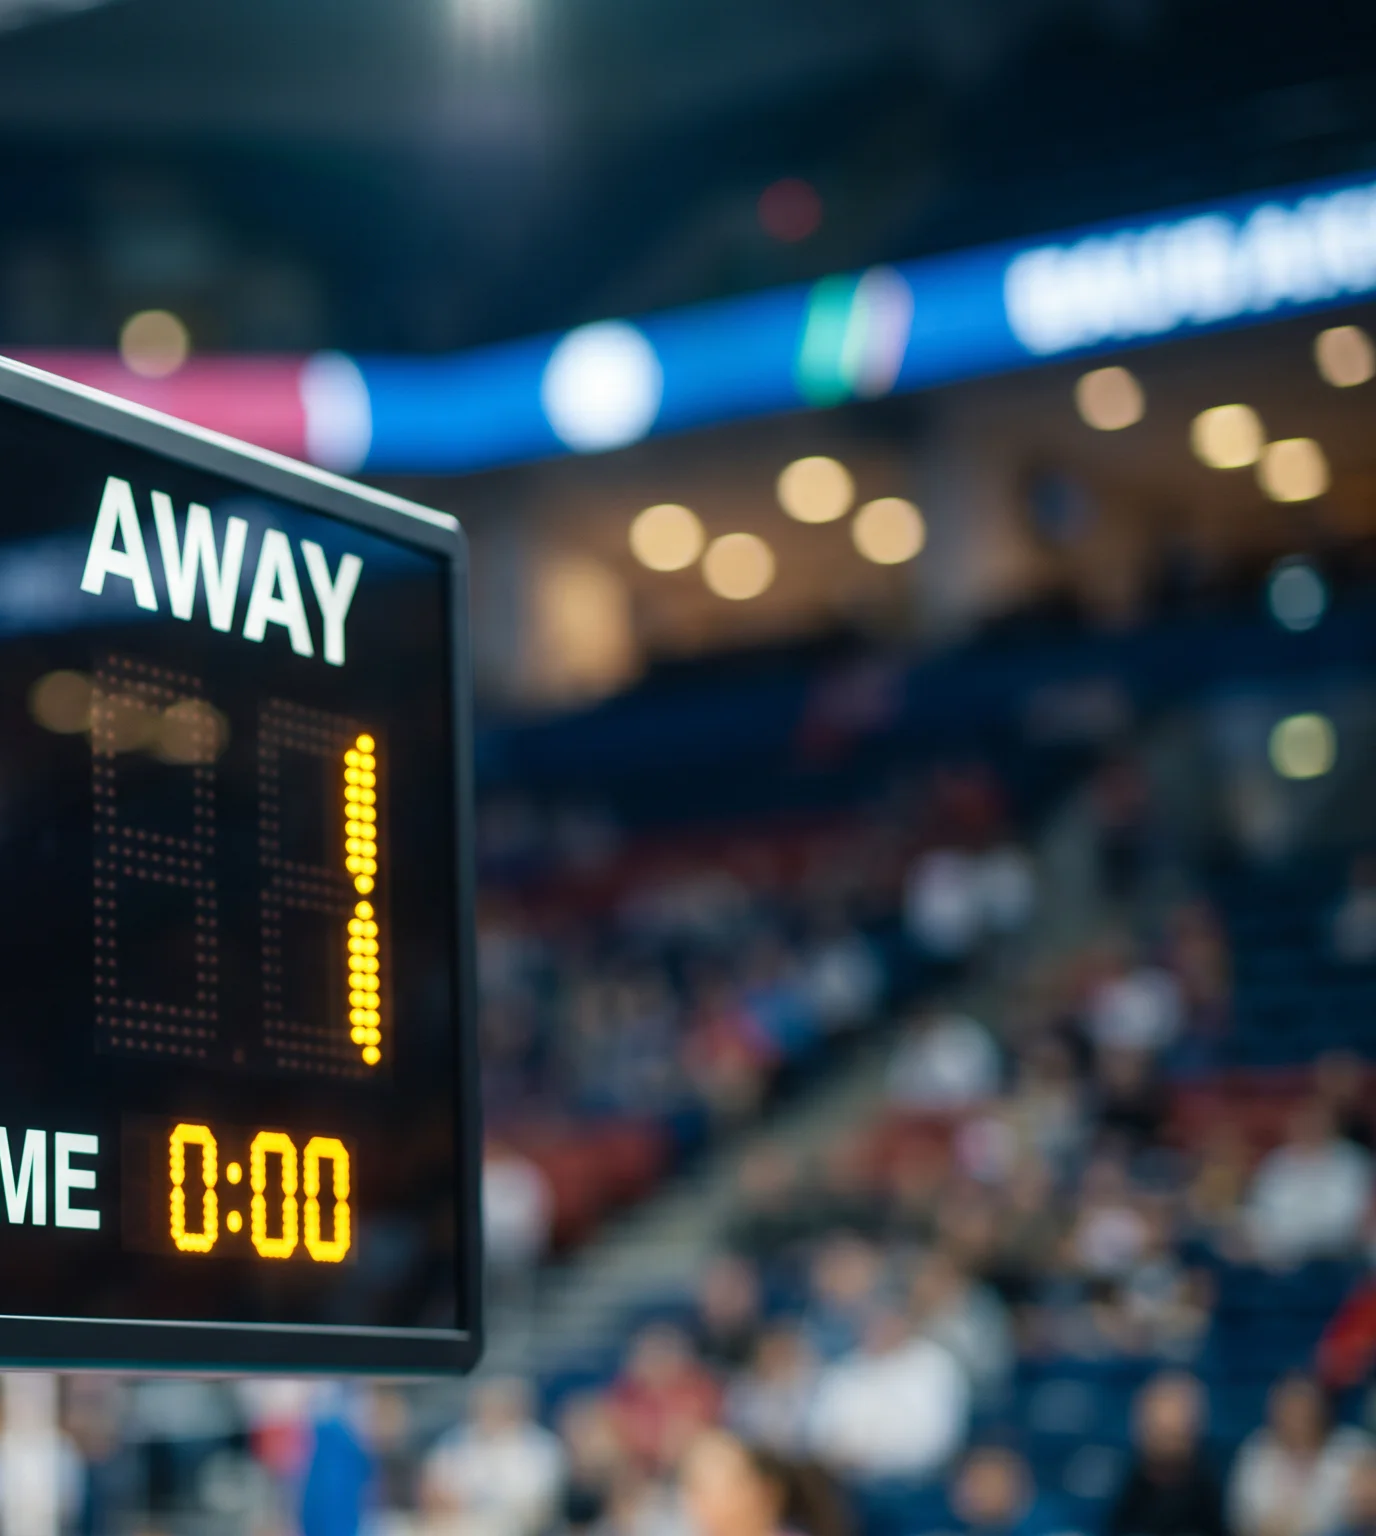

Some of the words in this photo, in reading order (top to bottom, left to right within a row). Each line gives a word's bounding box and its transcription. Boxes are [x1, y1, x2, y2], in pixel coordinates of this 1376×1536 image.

[80, 476, 363, 666] AWAY
[343, 733, 382, 1066] 1
[169, 1123, 352, 1263] 0:00
